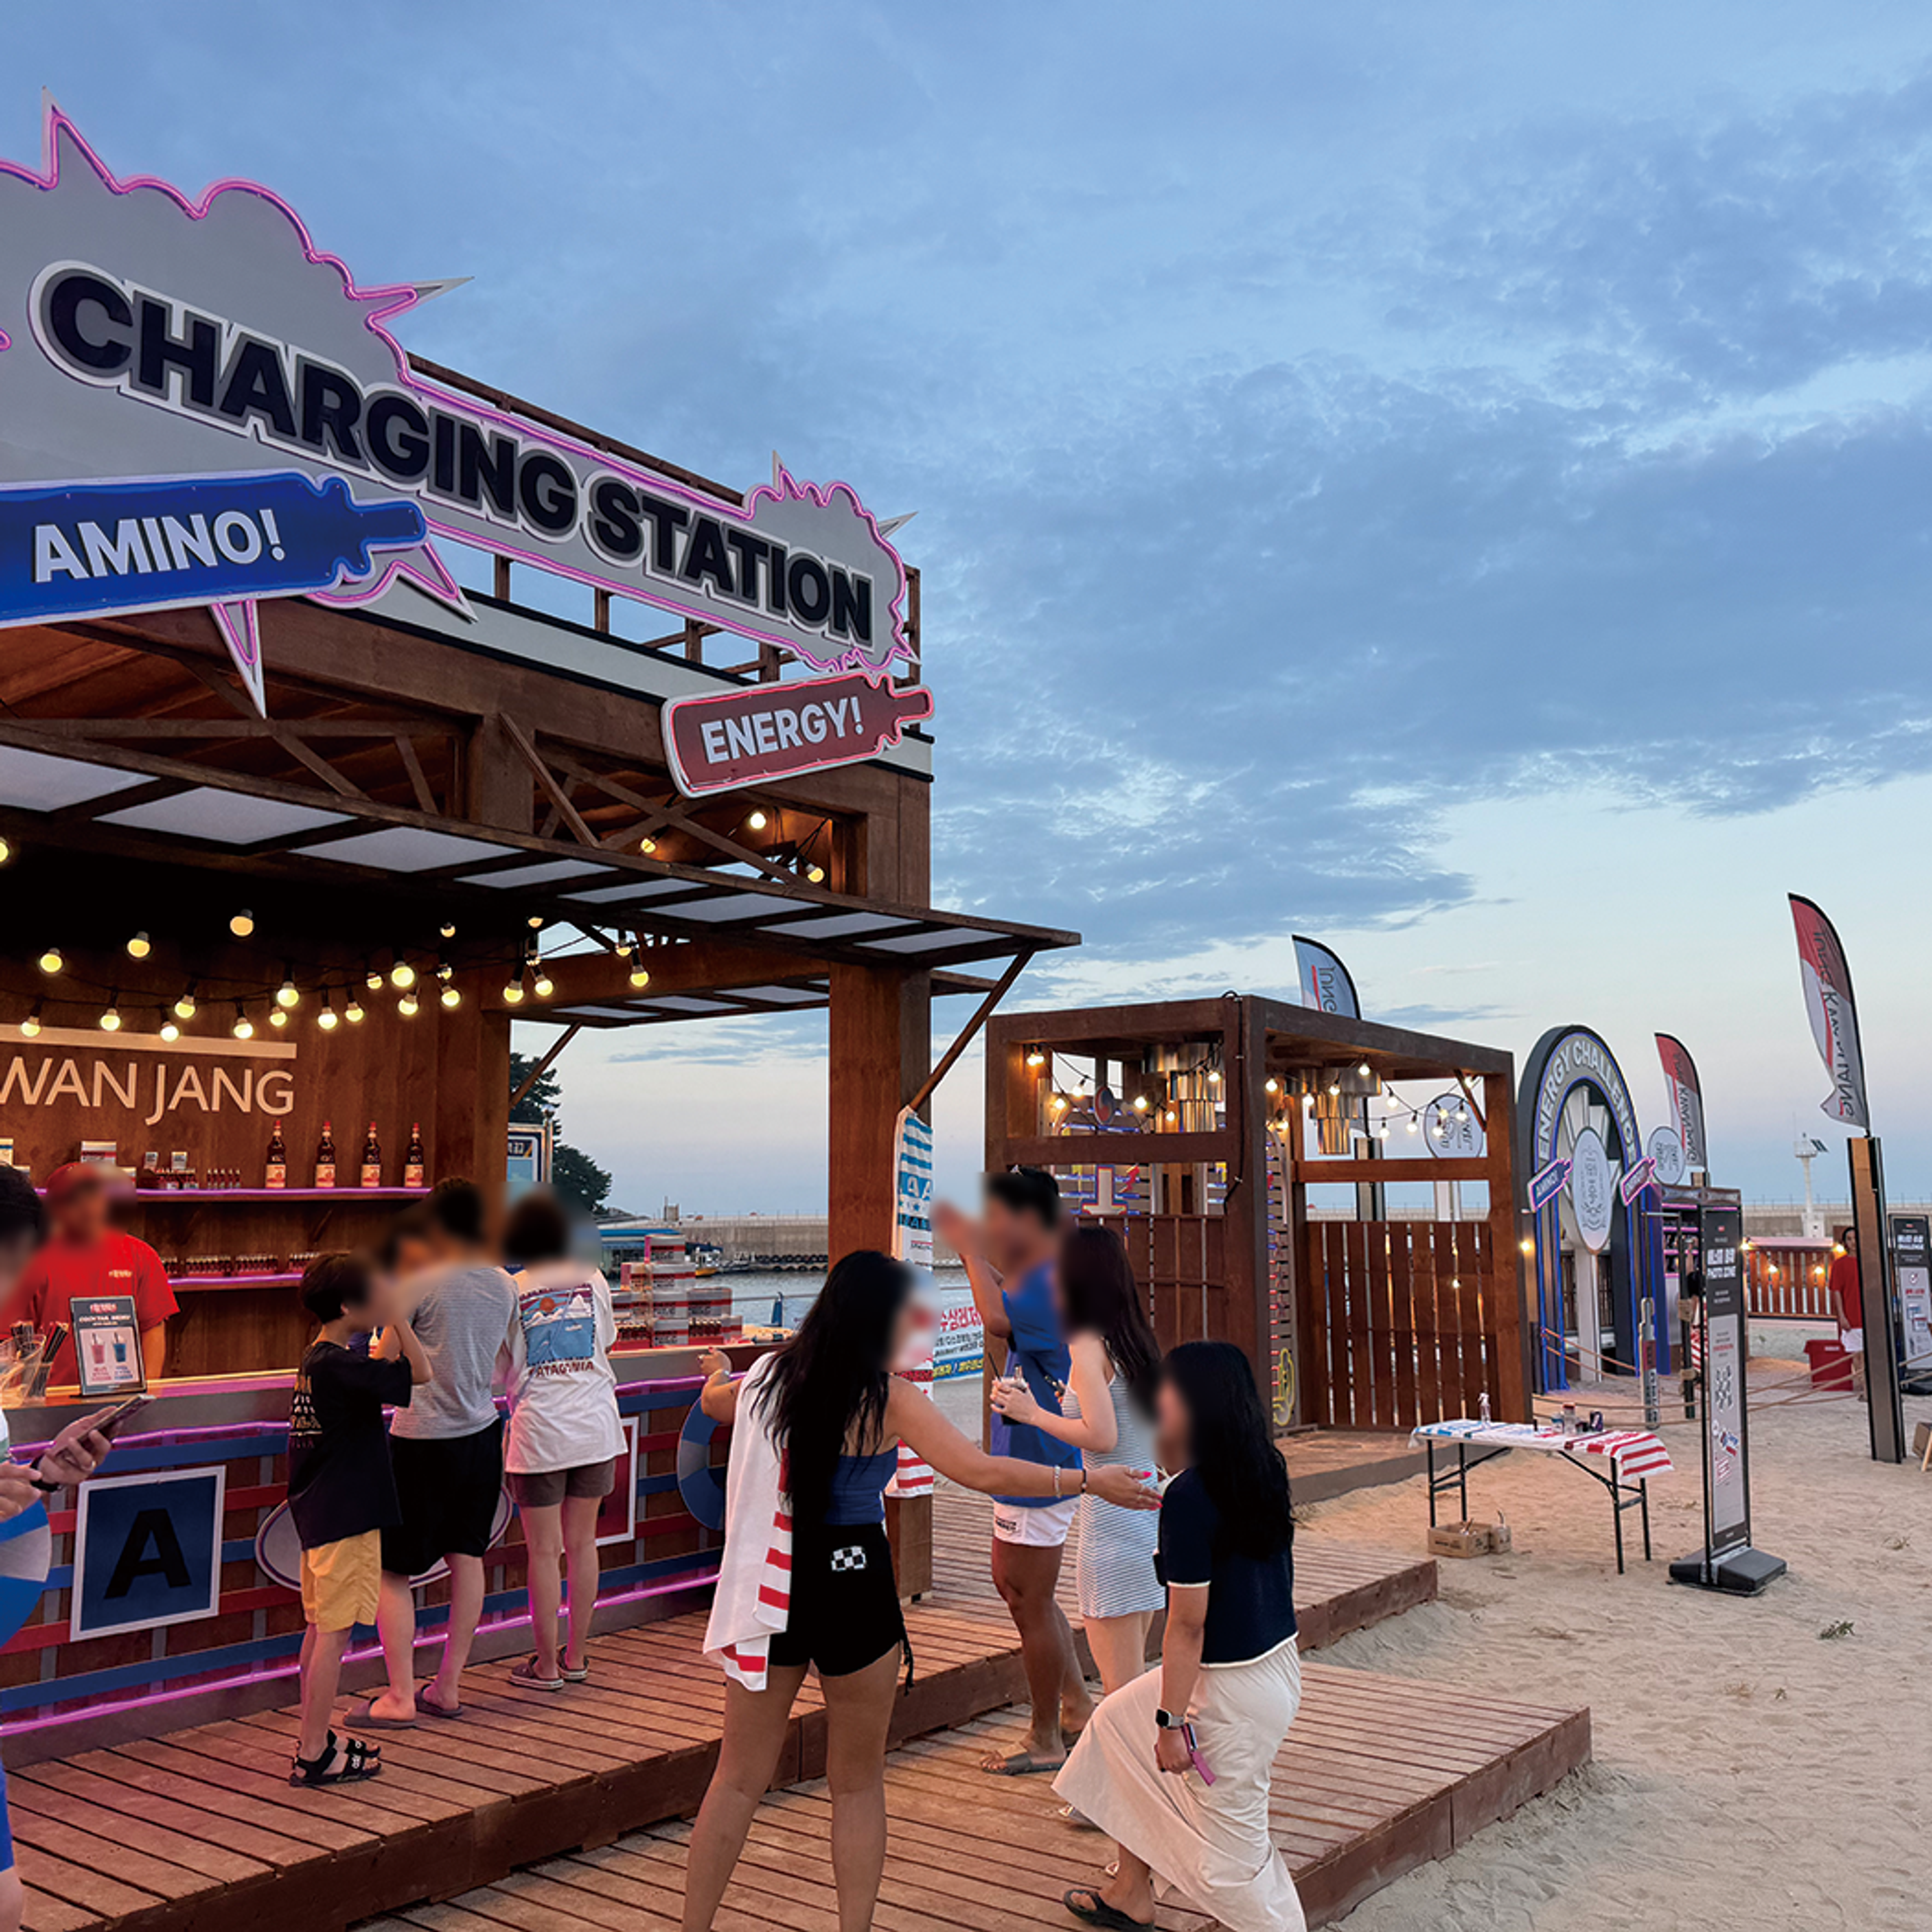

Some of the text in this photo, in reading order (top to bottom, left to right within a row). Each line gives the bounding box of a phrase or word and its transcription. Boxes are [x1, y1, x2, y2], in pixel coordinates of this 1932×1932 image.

[49, 274, 873, 644] CHARGING STATION
[34, 508, 285, 584] AMINO!
[700, 696, 864, 764] ENERGY!
[1538, 1049, 1571, 1163] ENERGY
[103, 1508, 192, 1600] A
